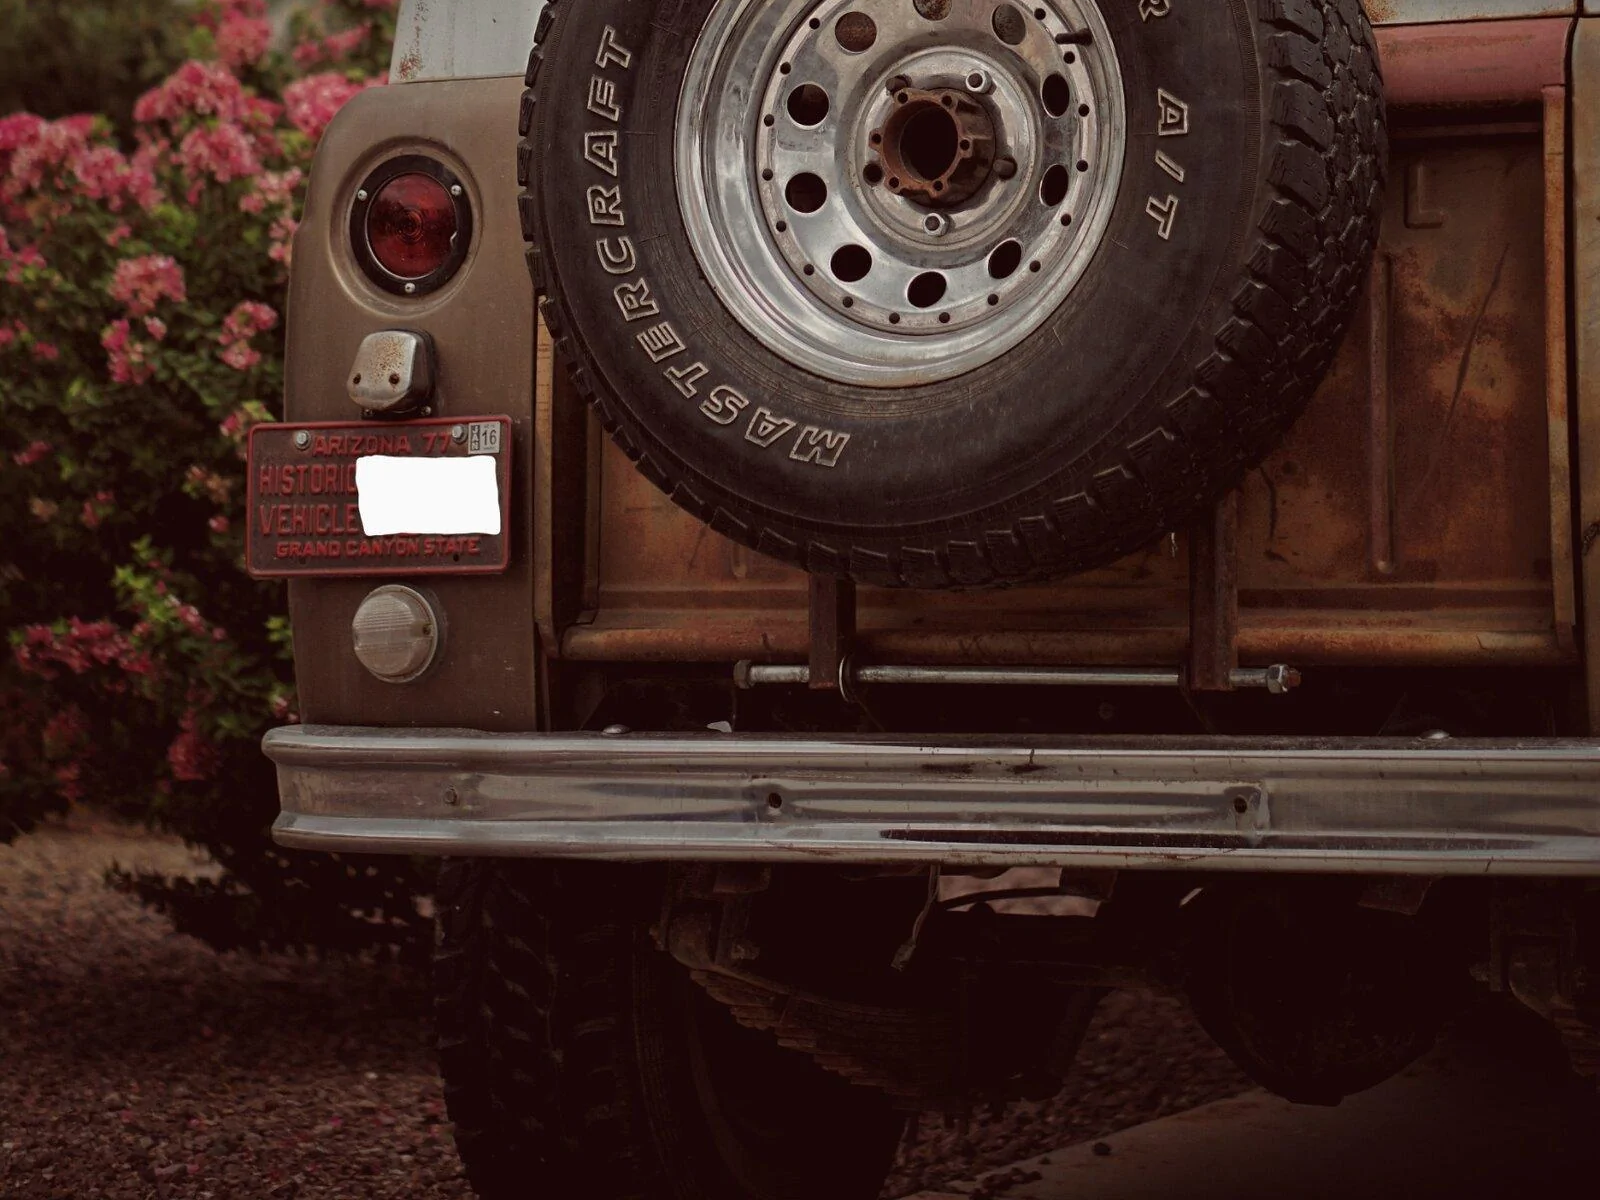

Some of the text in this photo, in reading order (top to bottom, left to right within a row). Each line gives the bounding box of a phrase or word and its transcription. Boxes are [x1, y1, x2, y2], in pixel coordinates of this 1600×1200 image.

[583, 24, 850, 468] MASTERCRAFT
[313, 433, 412, 456] ARIZONA
[471, 425, 480, 450] JAN
[482, 429, 497, 446] 16
[259, 463, 358, 495] HISTORIC
[259, 503, 360, 536] VEHICLE
[276, 535, 480, 558] GRAND CANYON STATE
